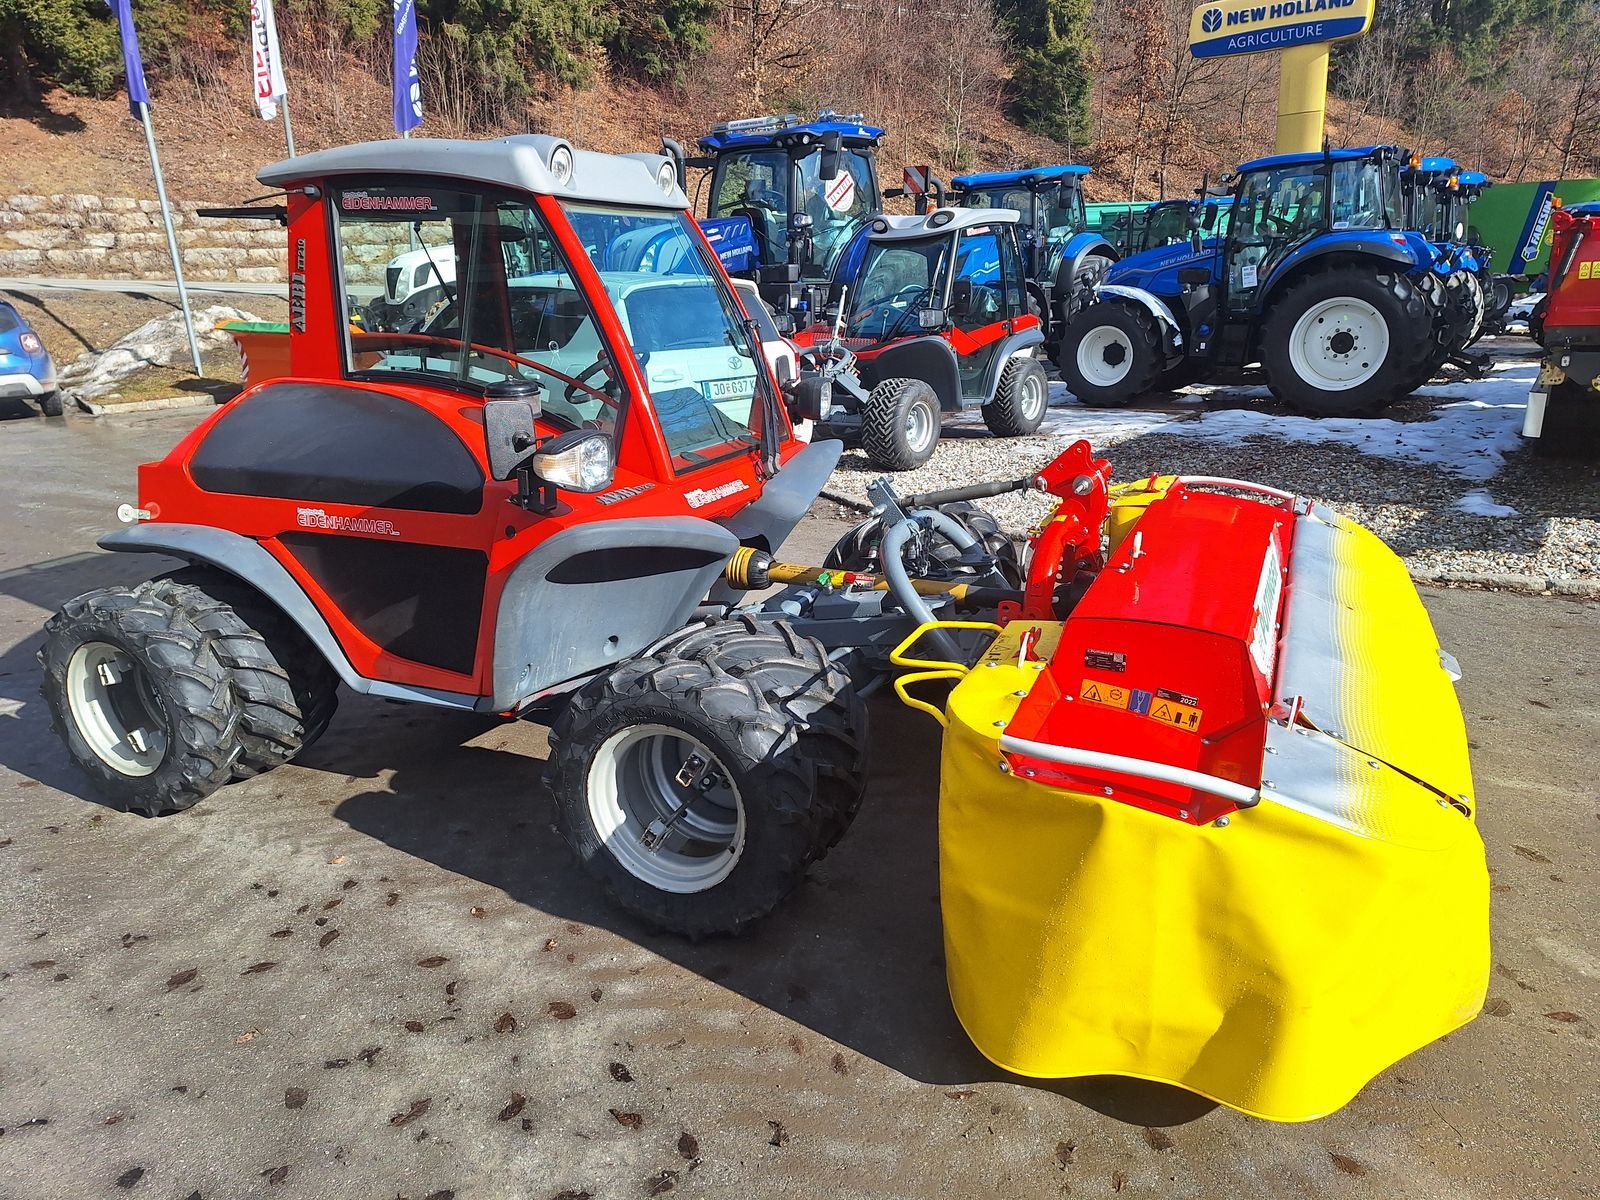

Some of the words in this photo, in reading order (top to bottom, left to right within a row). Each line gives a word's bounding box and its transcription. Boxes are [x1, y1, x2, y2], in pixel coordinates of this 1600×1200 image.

[1227, 7, 1267, 25] NEW
[1270, 0, 1354, 19] HOLLAND
[1228, 24, 1323, 49] AGRICULTURE
[342, 197, 432, 210] EIDENHAMMER
[1531, 200, 1552, 246] FARESIN
[720, 250, 732, 260] NEW
[732, 245, 752, 257] HOLLAND
[1160, 258, 1176, 267] NEW
[1177, 249, 1211, 263] HOLLAND
[291, 273, 306, 333] AEBI
[297, 514, 393, 535] EIDENHAMMER
[1179, 697, 1198, 707] 2022
